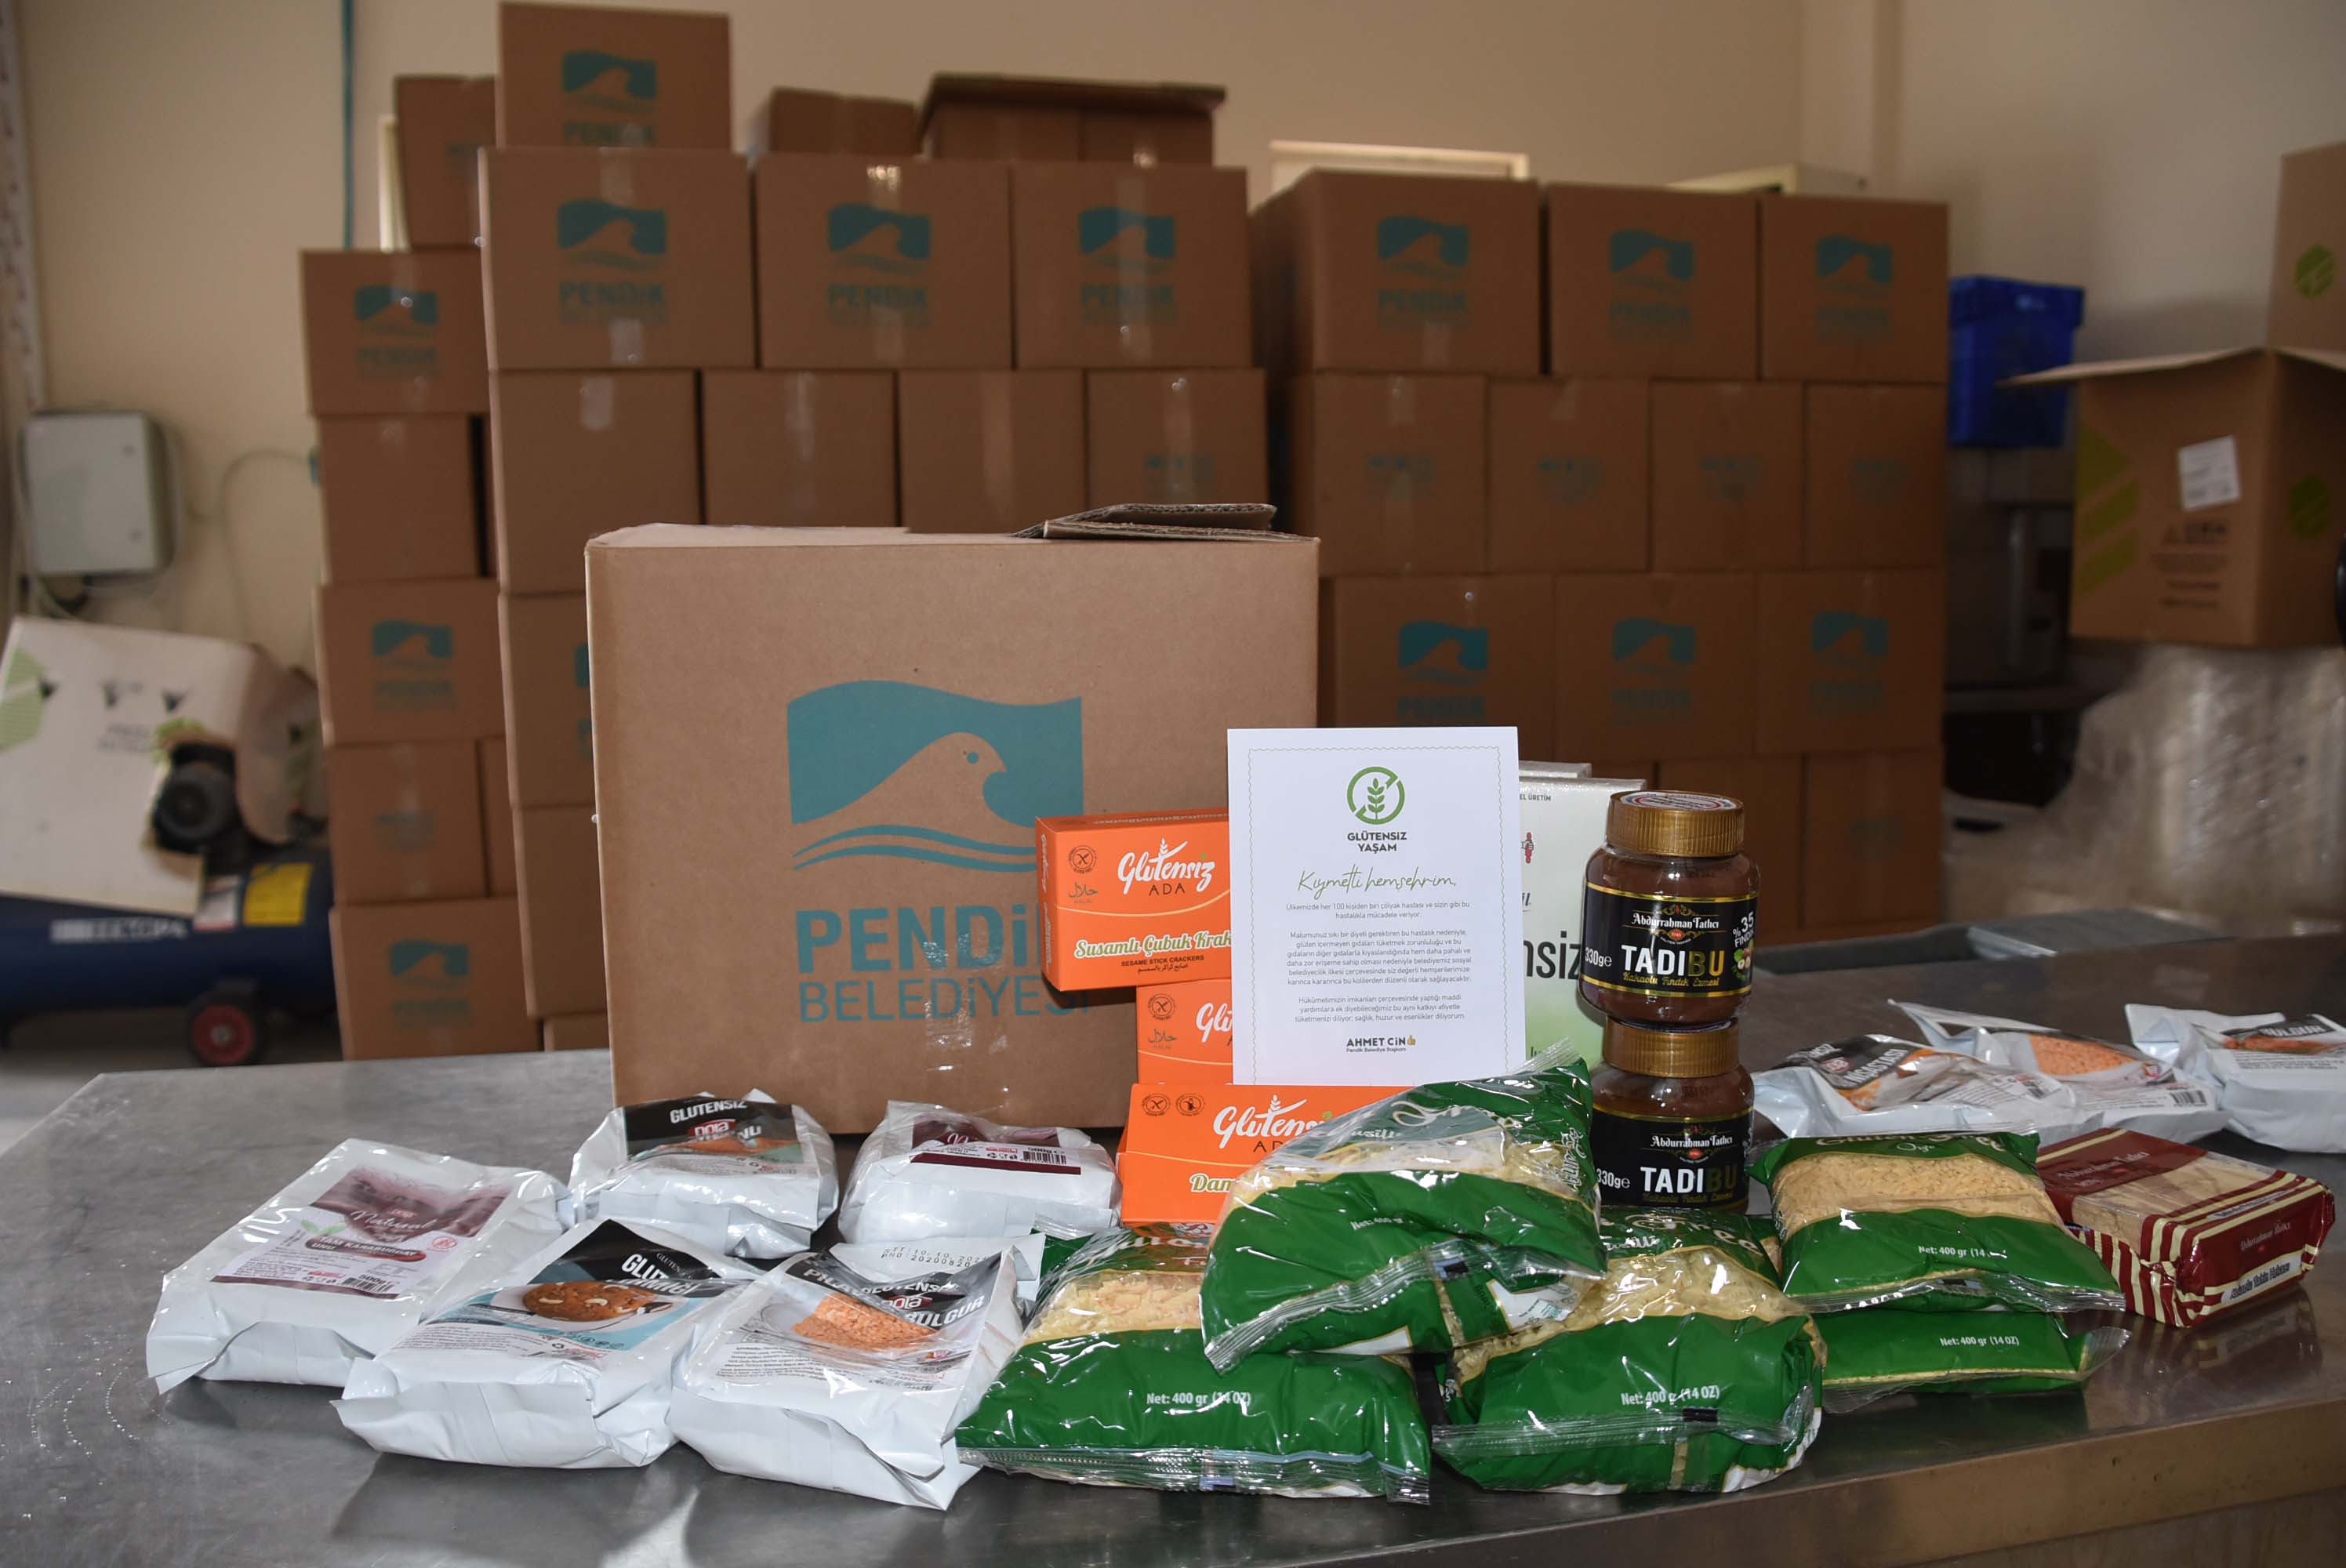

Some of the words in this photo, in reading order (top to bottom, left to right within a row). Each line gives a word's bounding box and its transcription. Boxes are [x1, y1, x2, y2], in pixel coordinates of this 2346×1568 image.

[1357, 842, 1397, 854] YAŞAM
[1149, 883, 1186, 896] ADA
[1631, 912, 1693, 930] Abdurrahman
[1741, 911, 1754, 933] 35
[796, 903, 1041, 974] PENDi
[1074, 937, 1140, 958] Susamlı
[1143, 933, 1191, 956] Çubuk
[1346, 1037, 1385, 1047] AHMET
[1650, 1135, 1709, 1148] Abdurrahman
[1939, 1247, 1956, 1255] 400
[1957, 1249, 1967, 1258] gr
[1940, 1338, 1960, 1346] Net:
[1960, 1337, 1977, 1345] 400
[1977, 1338, 1987, 1347] gr
[1989, 1336, 2004, 1345] (14
[1146, 1392, 1170, 1404] Net:
[1171, 1392, 1193, 1404] 400
[1195, 1394, 1208, 1406] gr
[1621, 1392, 1643, 1406] Net:
[1645, 1390, 1666, 1403] 400
[1701, 1385, 1720, 1399] OZ)
